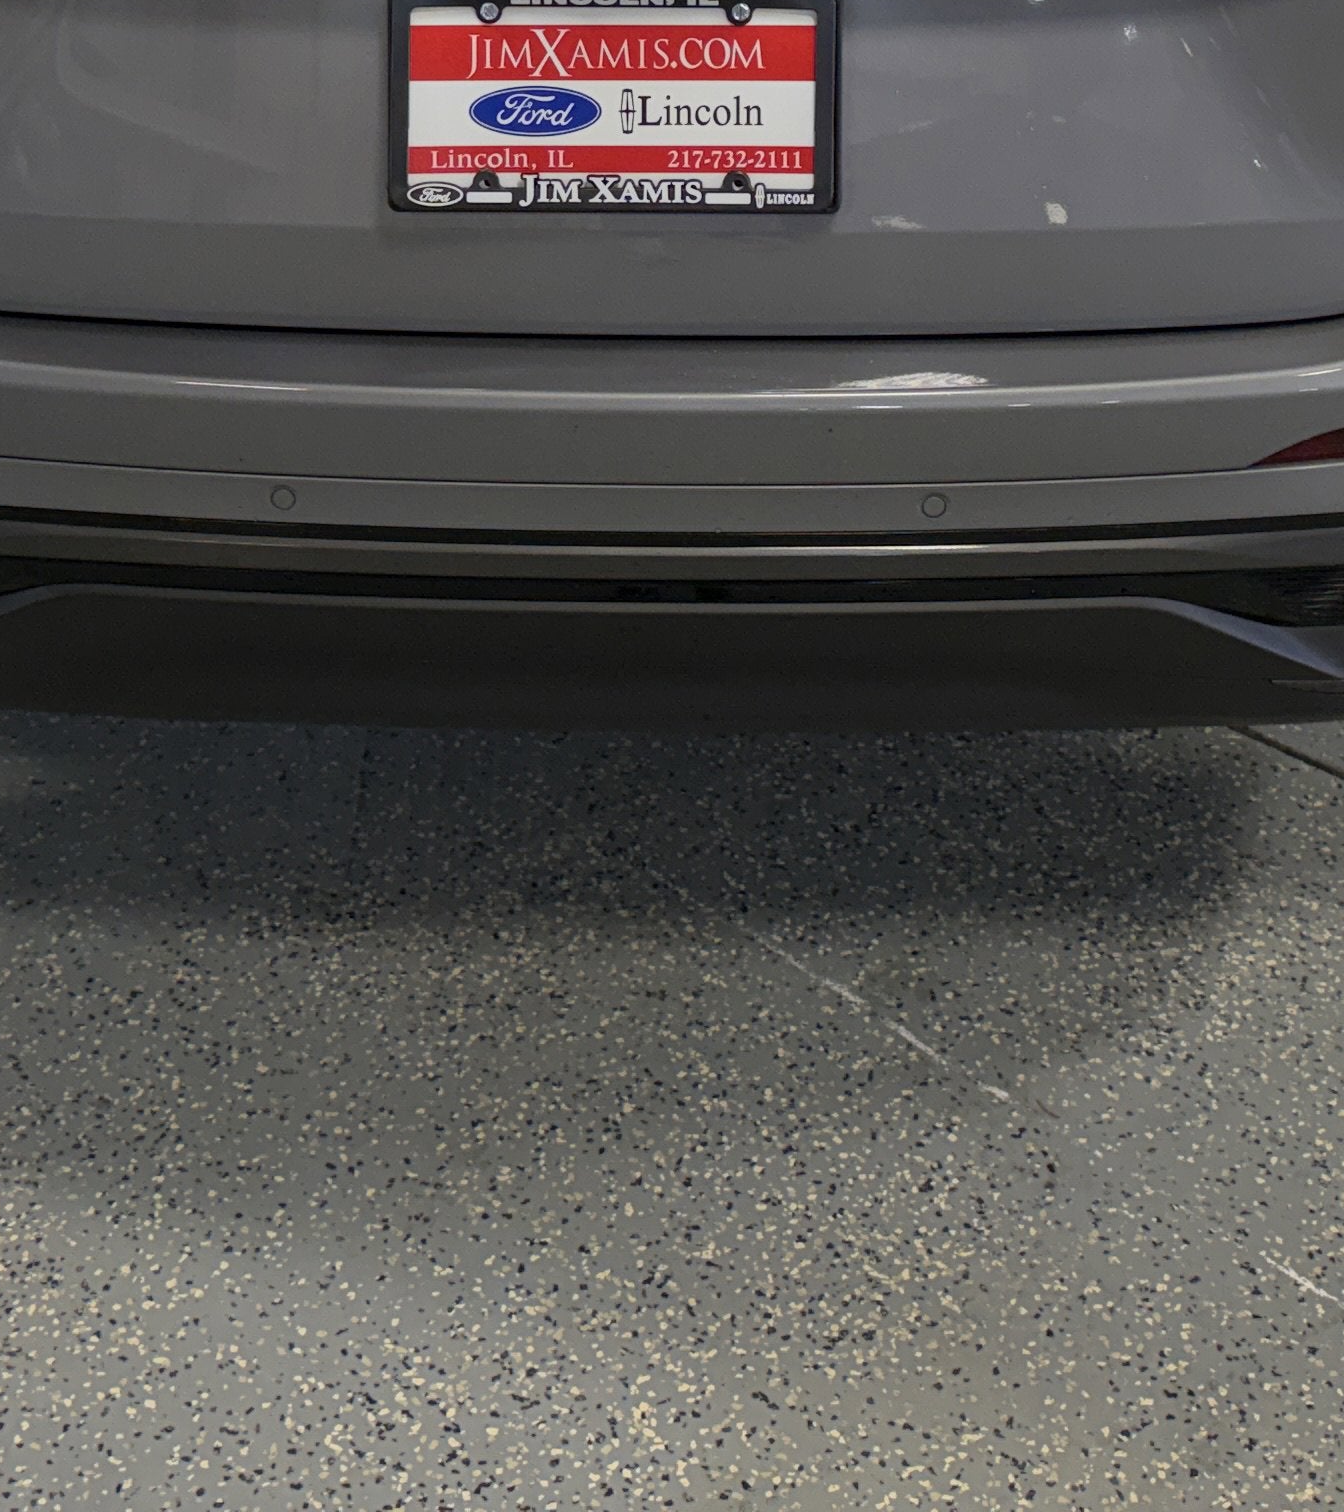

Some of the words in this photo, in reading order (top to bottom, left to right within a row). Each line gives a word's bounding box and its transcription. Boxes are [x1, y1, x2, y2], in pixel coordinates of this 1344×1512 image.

[467, 28, 766, 80] JIMXAMIS.COM
[495, 92, 574, 128] Ford
[636, 94, 765, 127] Lincoln
[430, 149, 538, 172] Lincoln,
[547, 149, 574, 169] IL
[667, 149, 803, 170] 217-732-2111
[518, 173, 582, 207] JIM
[588, 174, 703, 205] XAMIS
[766, 193, 815, 206] LINCOLN
